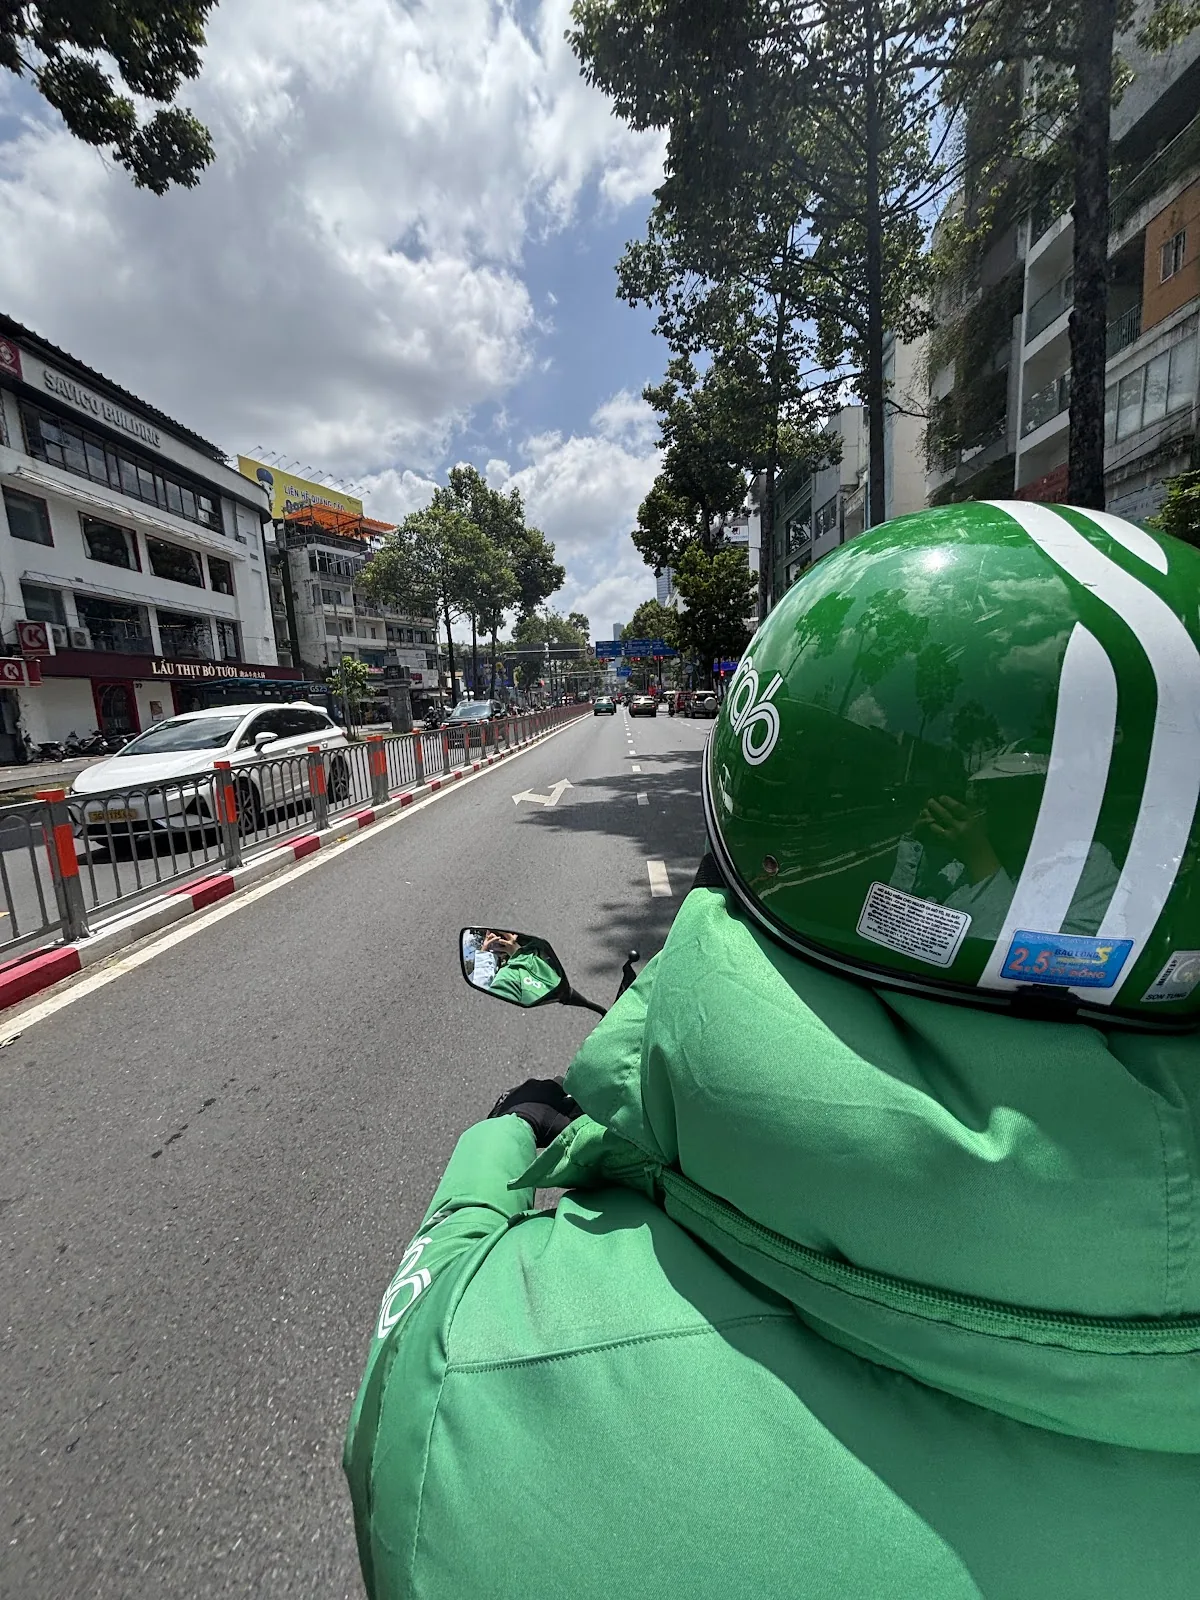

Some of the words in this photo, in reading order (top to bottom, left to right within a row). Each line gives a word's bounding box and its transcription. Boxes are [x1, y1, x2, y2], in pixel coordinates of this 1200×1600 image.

[43, 370, 100, 415] SAVICO
[101, 402, 161, 448] BUILDING
[175, 664, 201, 679] THỊT
[202, 663, 215, 677] BÒ
[215, 666, 238, 678] TƯƠI
[309, 684, 328, 693] GS25
[1008, 947, 1053, 974] 2.5
